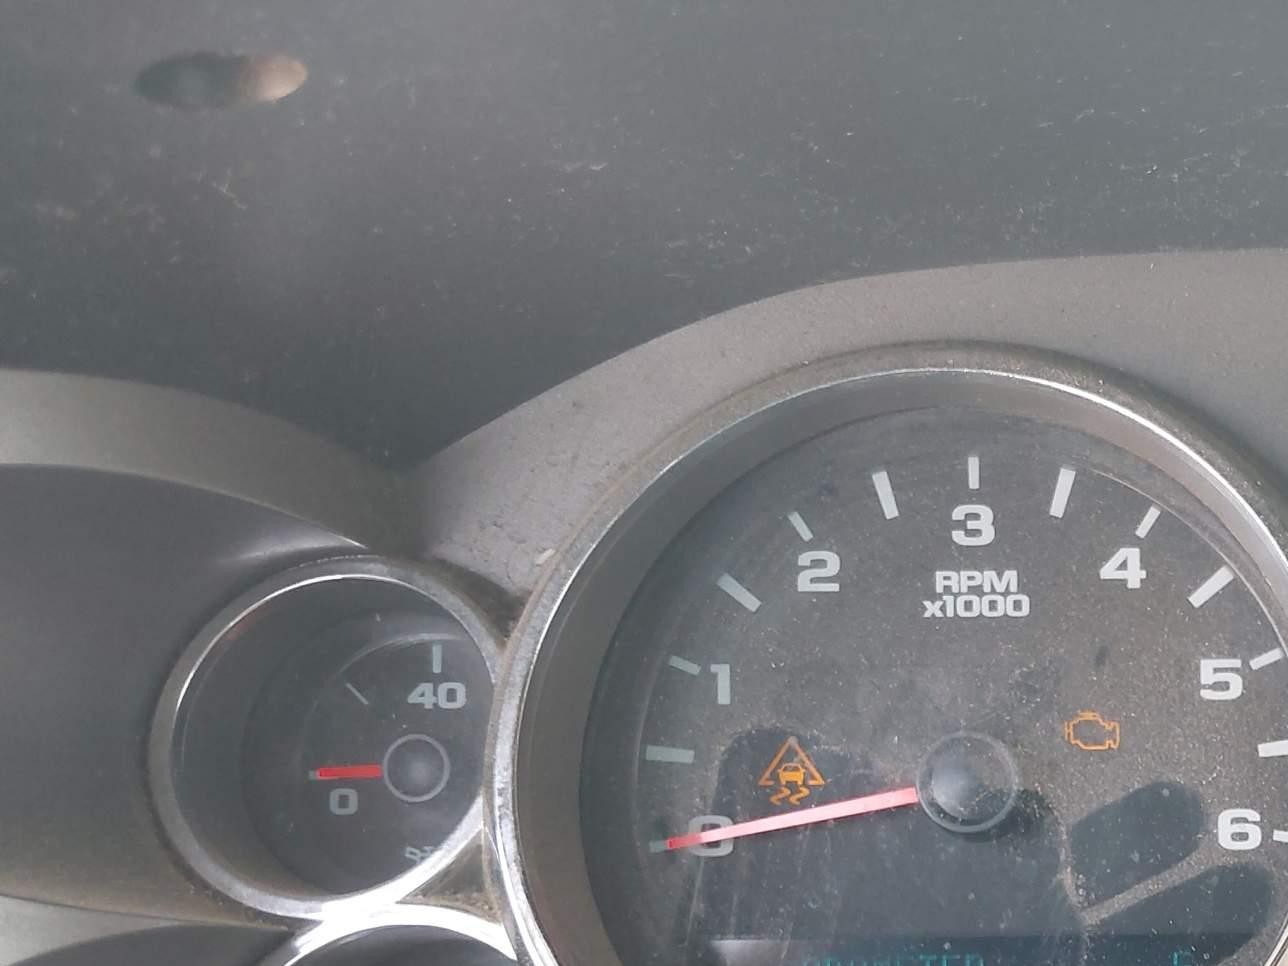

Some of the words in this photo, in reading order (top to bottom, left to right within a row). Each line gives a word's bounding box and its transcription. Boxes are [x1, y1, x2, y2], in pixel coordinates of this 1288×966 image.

[951, 504, 996, 546] 3
[797, 551, 840, 592] 2
[935, 571, 1018, 593] RPM
[1100, 548, 1145, 588] 4
[923, 595, 1030, 618] x1000
[407, 682, 467, 709] 40
[710, 664, 731, 704] 1
[1200, 659, 1243, 699] 5
[329, 789, 358, 815] 0
[688, 816, 735, 856] 0
[1217, 808, 1261, 850] 6
